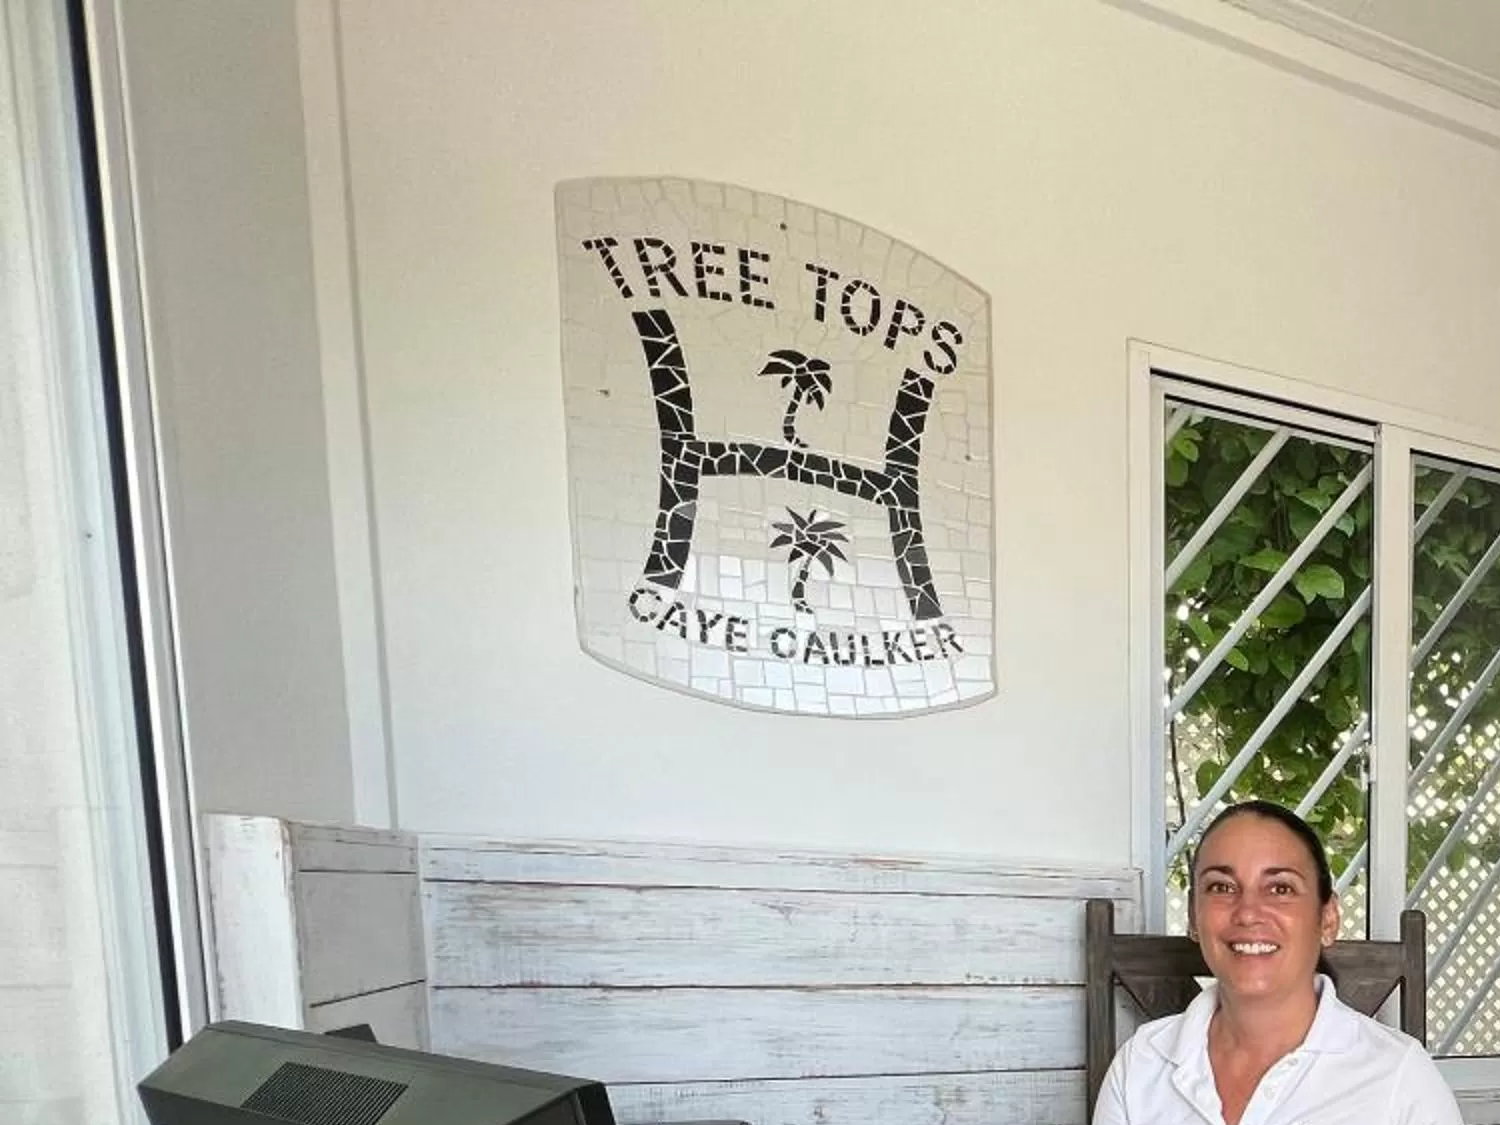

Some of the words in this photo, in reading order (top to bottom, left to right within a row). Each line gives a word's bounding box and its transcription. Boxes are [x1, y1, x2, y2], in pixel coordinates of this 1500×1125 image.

[581, 236, 775, 310] TREE
[805, 262, 963, 375] TOPS
[627, 587, 749, 653] CAYE
[768, 622, 965, 668] CAULKER
